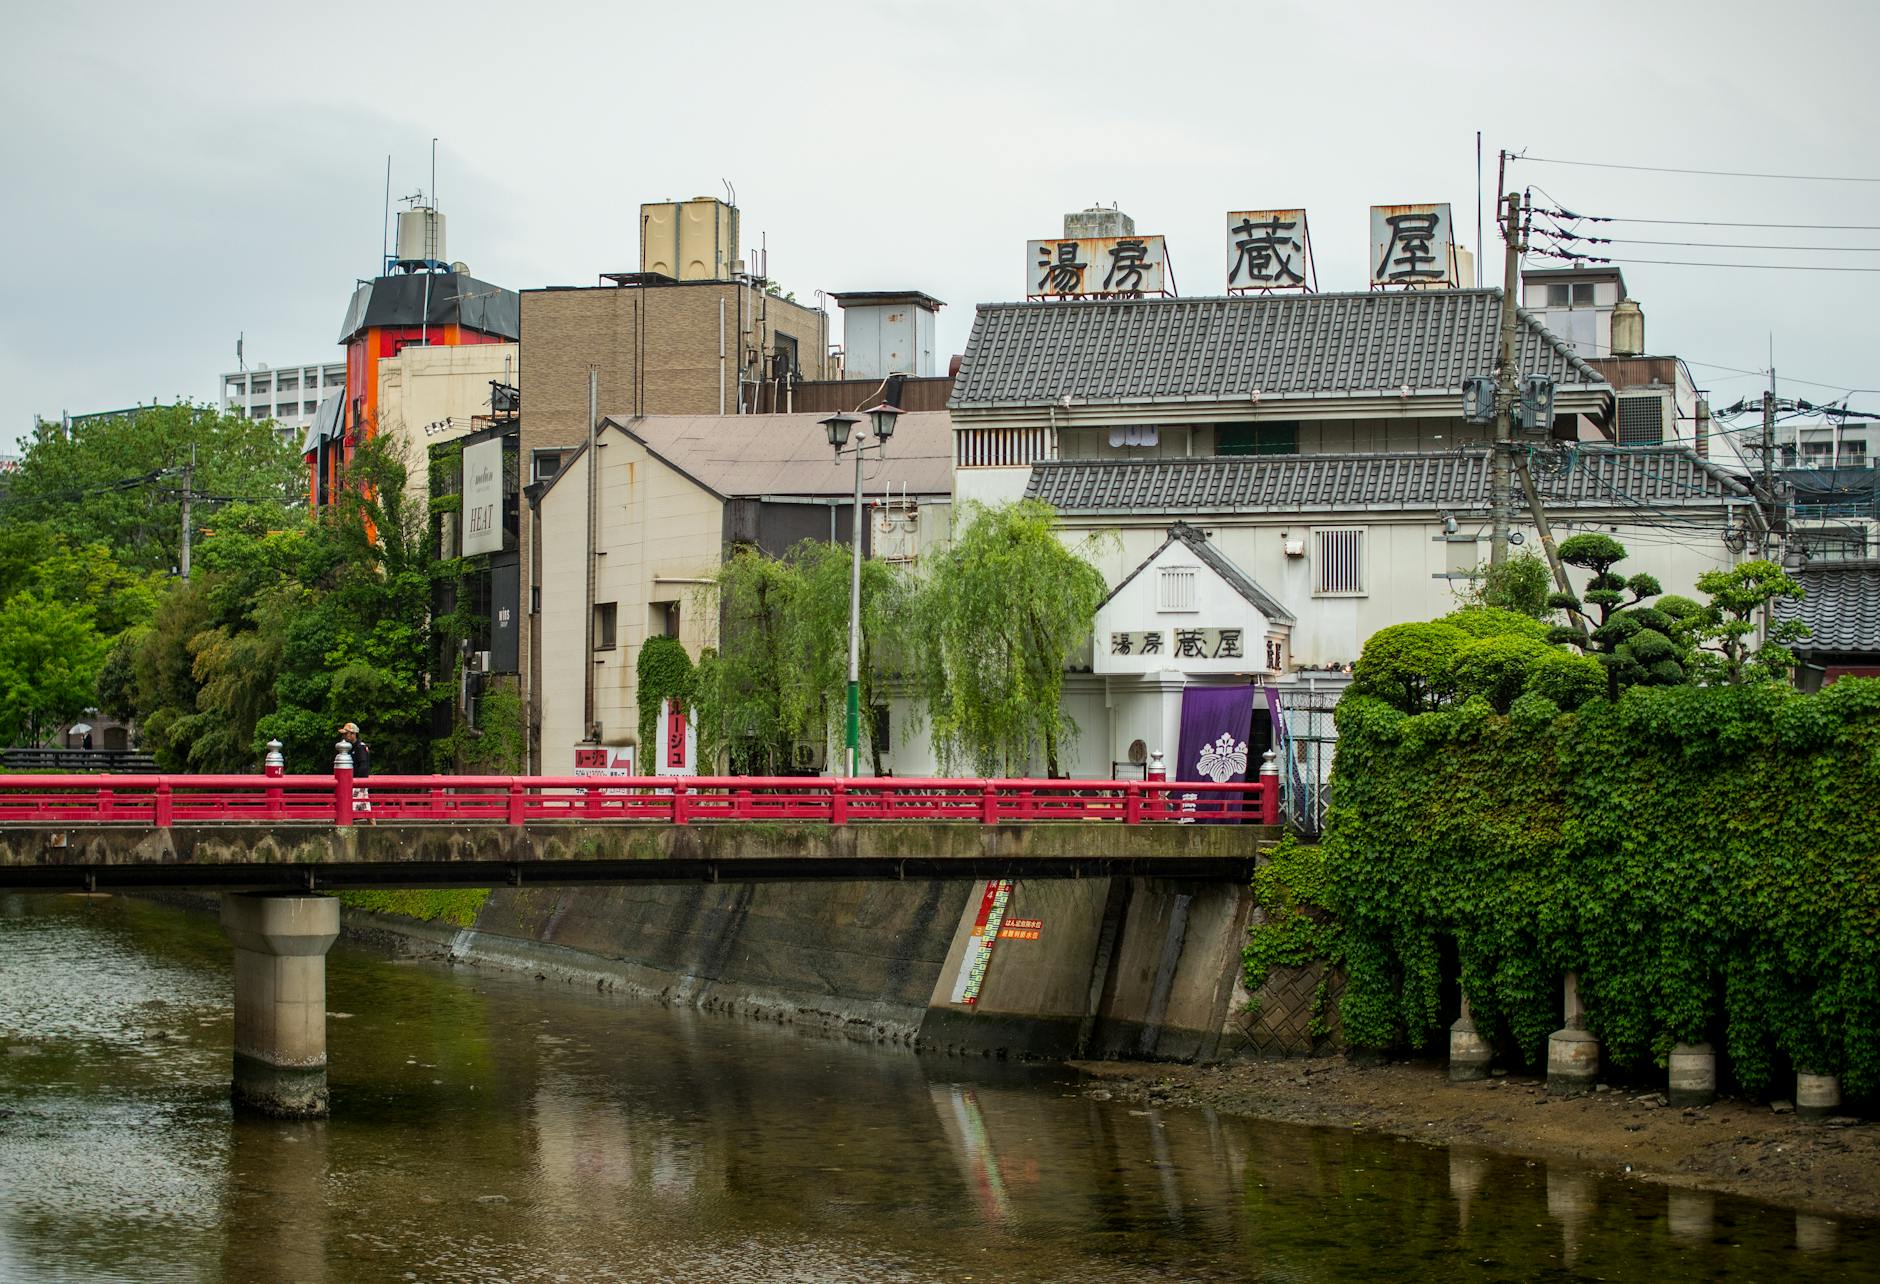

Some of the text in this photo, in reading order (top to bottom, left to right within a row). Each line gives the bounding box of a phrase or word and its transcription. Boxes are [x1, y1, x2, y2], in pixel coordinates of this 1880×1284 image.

[1038, 240, 1153, 292] 湯房
[1376, 212, 1446, 281] 屋
[470, 504, 494, 532] HEAT
[1111, 632, 1164, 656] 湯房
[1174, 628, 1244, 659] 蔵屋
[577, 751, 606, 766] ルージュ
[987, 891, 994, 899] 4
[976, 927, 982, 935] 3
